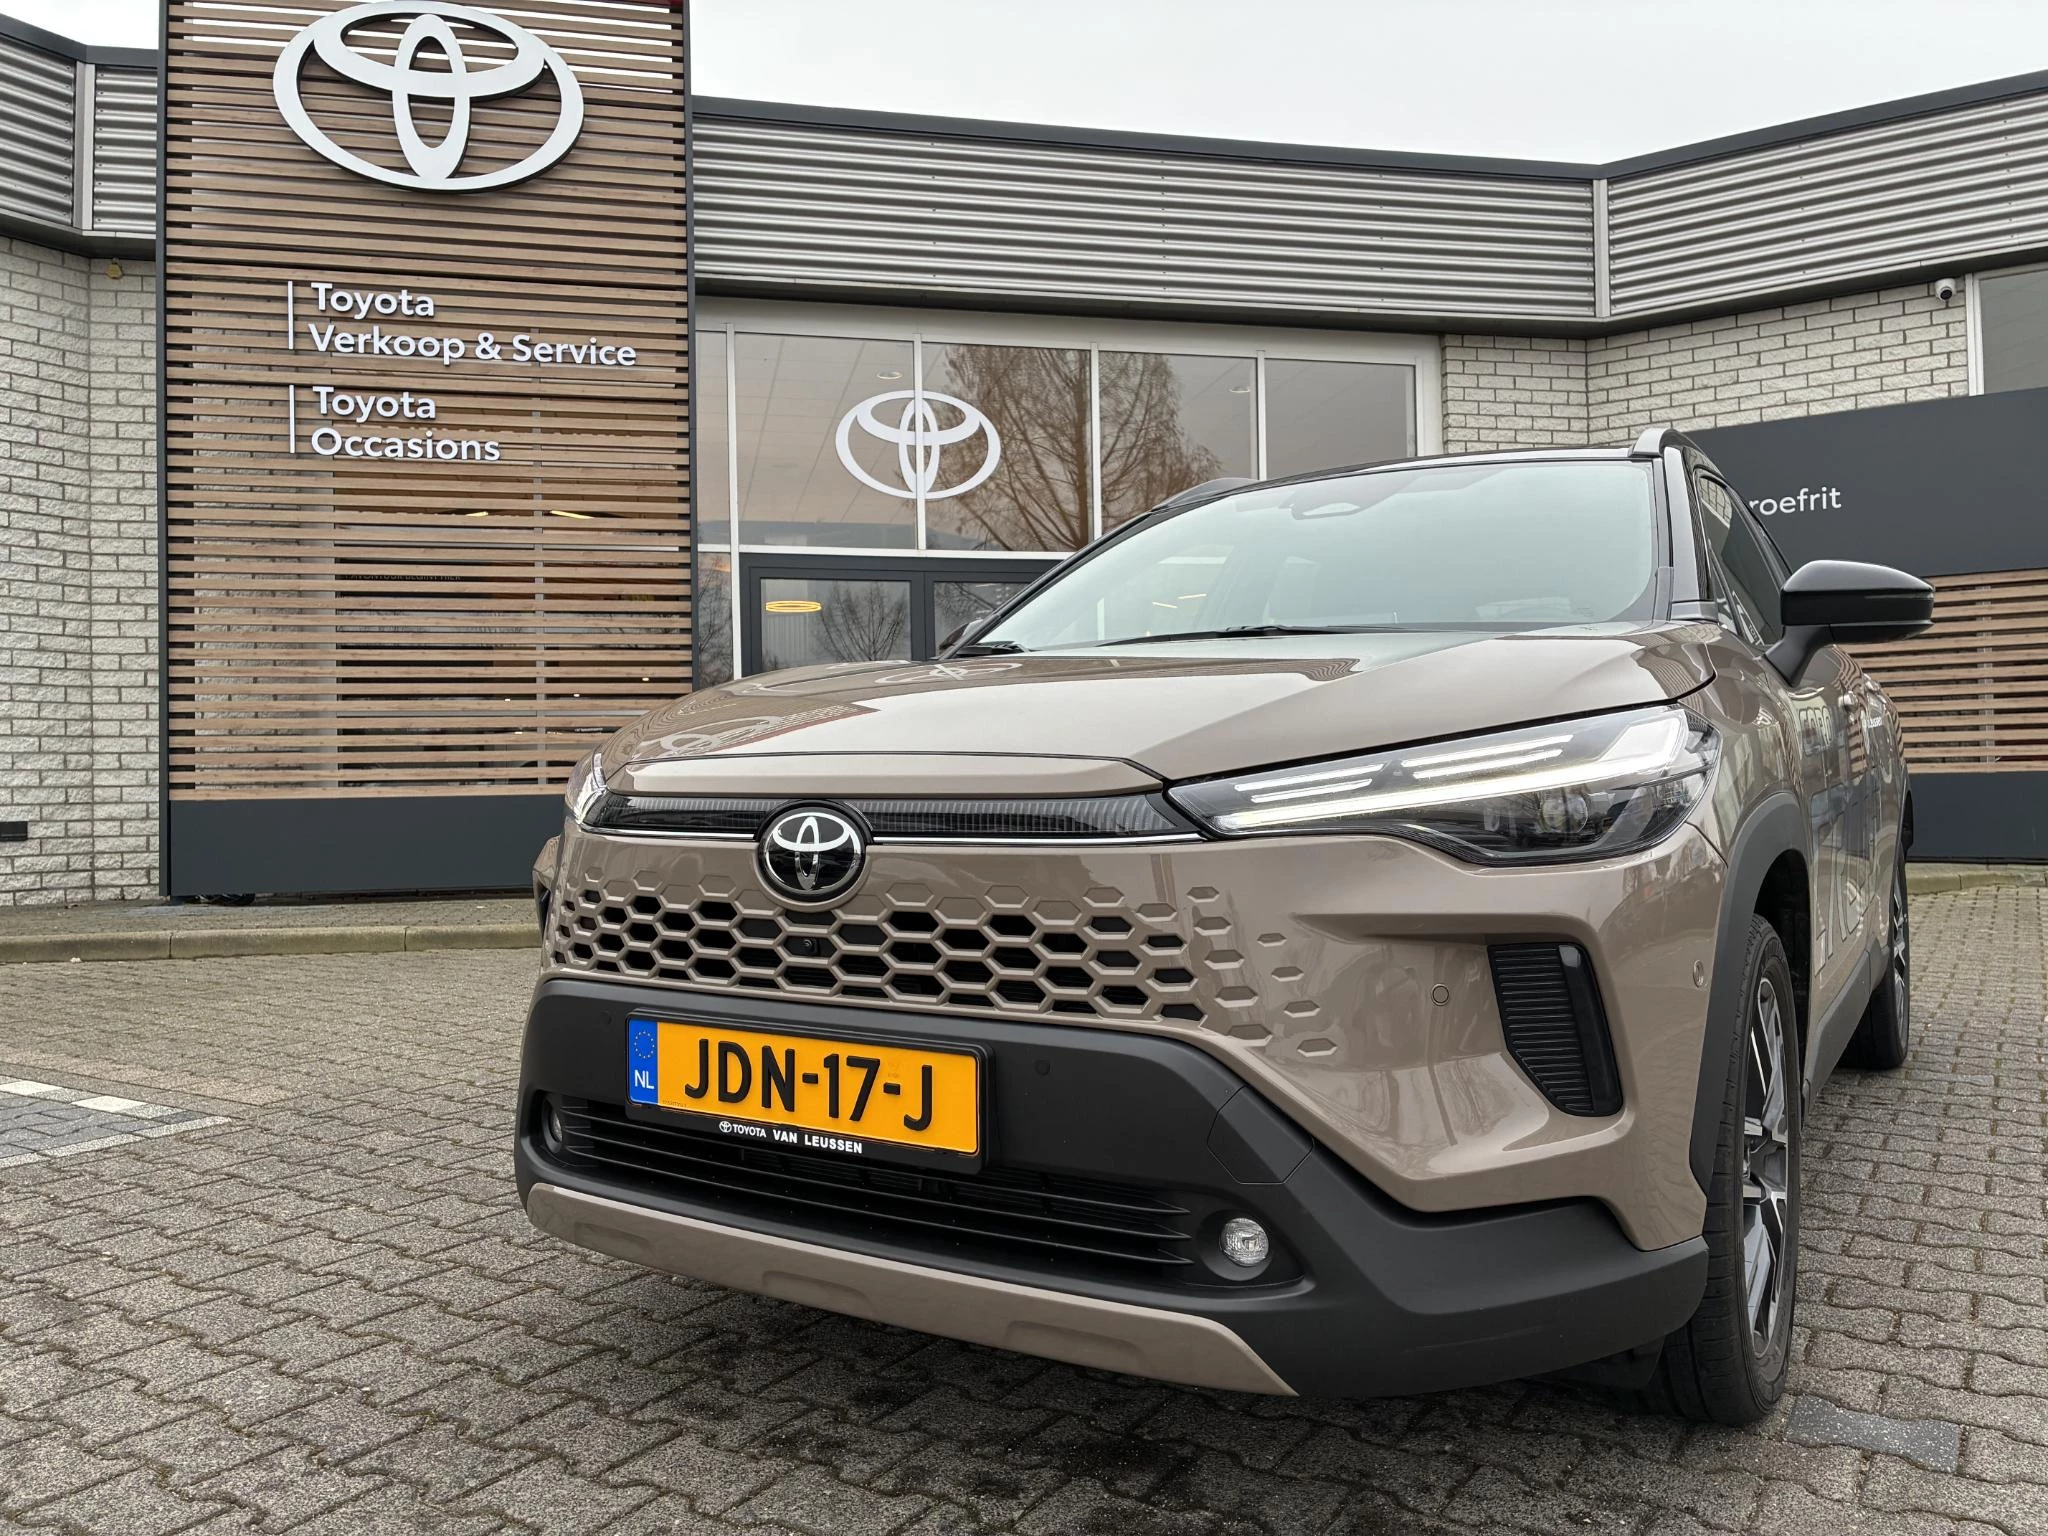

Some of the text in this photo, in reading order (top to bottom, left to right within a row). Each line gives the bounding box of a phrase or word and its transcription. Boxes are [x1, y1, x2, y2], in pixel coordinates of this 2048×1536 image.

[310, 282, 435, 320] Toyota
[308, 323, 637, 366] Verkoop & Service
[312, 386, 437, 423] Toyota
[311, 427, 501, 461] Occasions
[1748, 486, 1842, 516] roefrit
[634, 1069, 655, 1090] NL
[684, 1038, 933, 1132] JDN-17-J
[732, 1123, 863, 1154] TOYOTA VAN LEUSSEN
